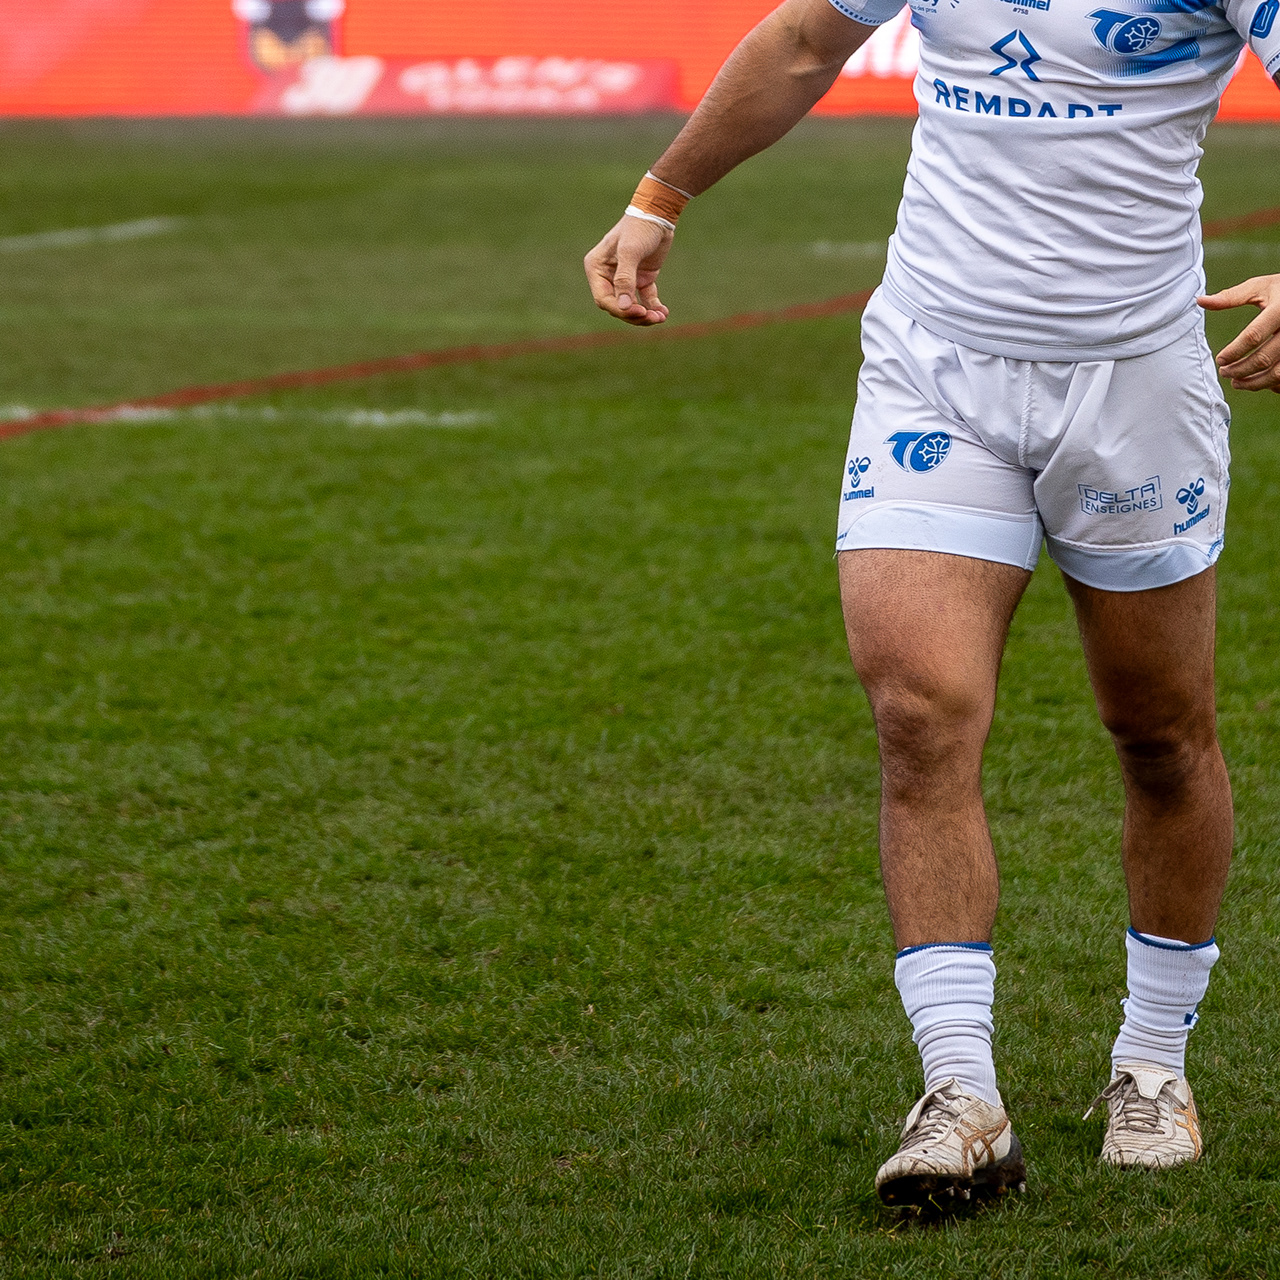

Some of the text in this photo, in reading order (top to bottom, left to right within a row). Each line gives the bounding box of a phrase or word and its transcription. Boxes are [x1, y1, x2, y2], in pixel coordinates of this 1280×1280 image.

[1084, 482, 1156, 504] DELTA
[1085, 497, 1158, 514] ENSEIGNES
[1173, 504, 1211, 536] hummel
